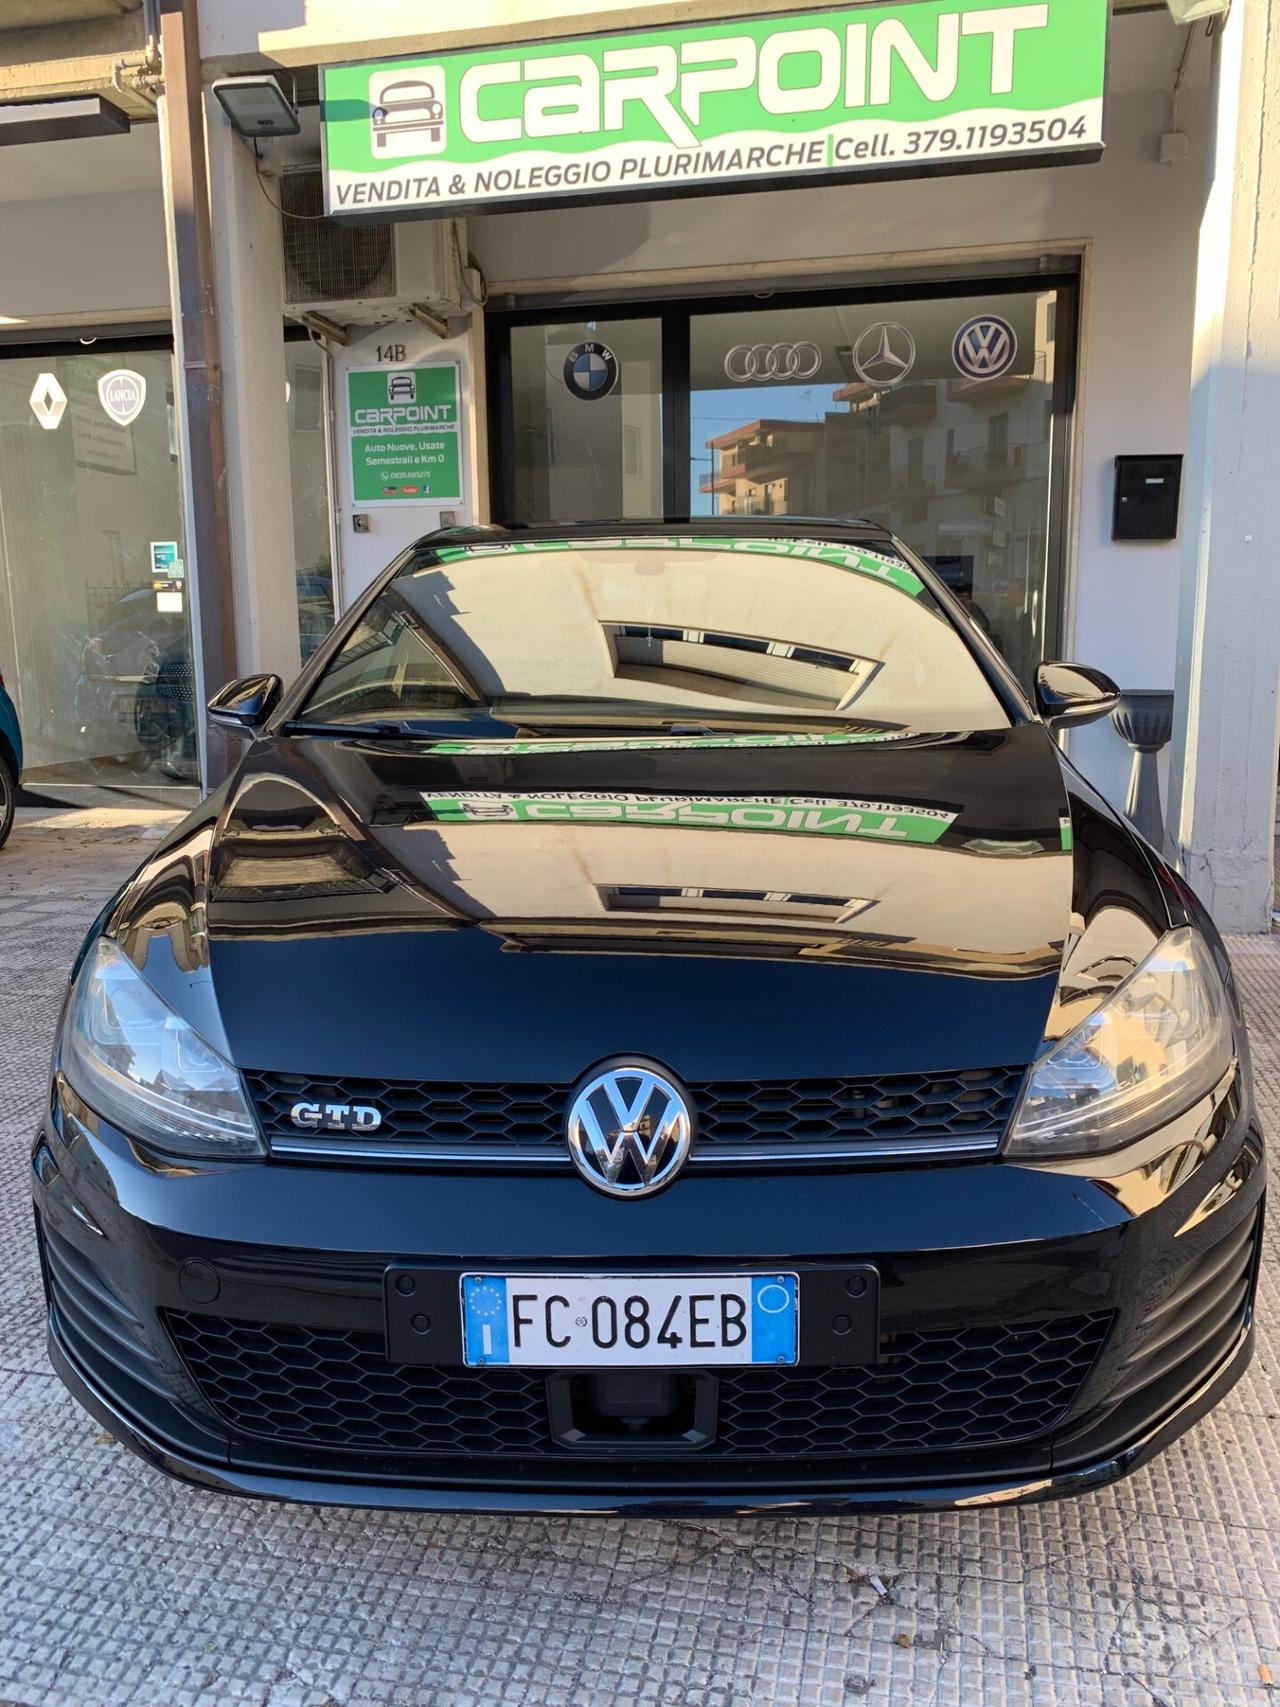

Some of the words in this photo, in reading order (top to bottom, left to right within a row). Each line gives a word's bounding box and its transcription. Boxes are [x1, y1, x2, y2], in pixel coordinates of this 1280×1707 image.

[336, 176, 441, 205] VENDITA
[448, 174, 466, 195] &
[474, 161, 611, 193] NOLEGGIO
[620, 140, 823, 181] PLURIMARCHE
[834, 132, 895, 161] Cell.
[903, 115, 1088, 155] 379.1193504
[376, 344, 406, 363] 14B
[569, 341, 614, 363] BMW
[110, 388, 137, 402] LANCIA
[353, 427, 377, 435] VENDITA
[365, 444, 385, 452] Auto
[387, 443, 417, 452] Nuove,
[418, 441, 445, 450] Usate
[366, 456, 413, 466] Semestrali
[421, 454, 437, 463] Km
[290, 1102, 382, 1132] GTD
